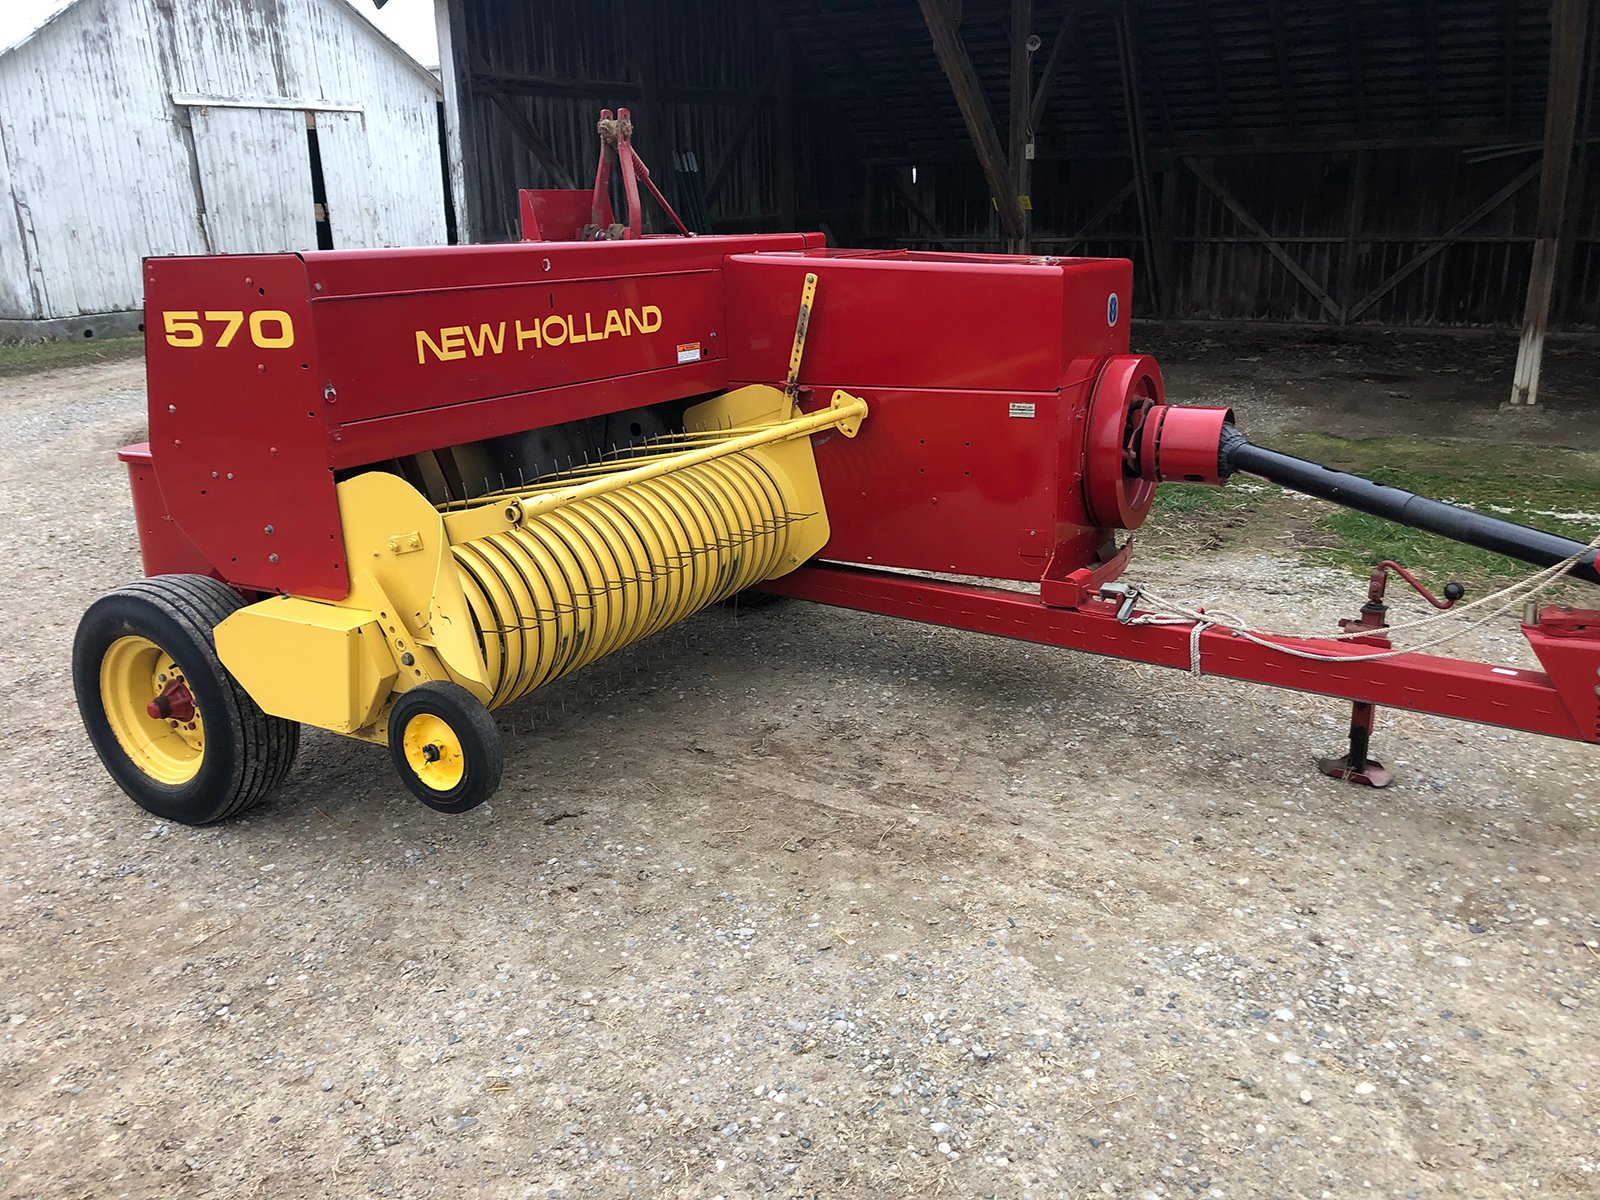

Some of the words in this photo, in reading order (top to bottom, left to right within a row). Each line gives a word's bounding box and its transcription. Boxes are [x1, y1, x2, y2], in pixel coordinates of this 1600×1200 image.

[162, 309, 295, 349] 570
[415, 321, 506, 364] NEW
[515, 305, 662, 351] HOLLAND
